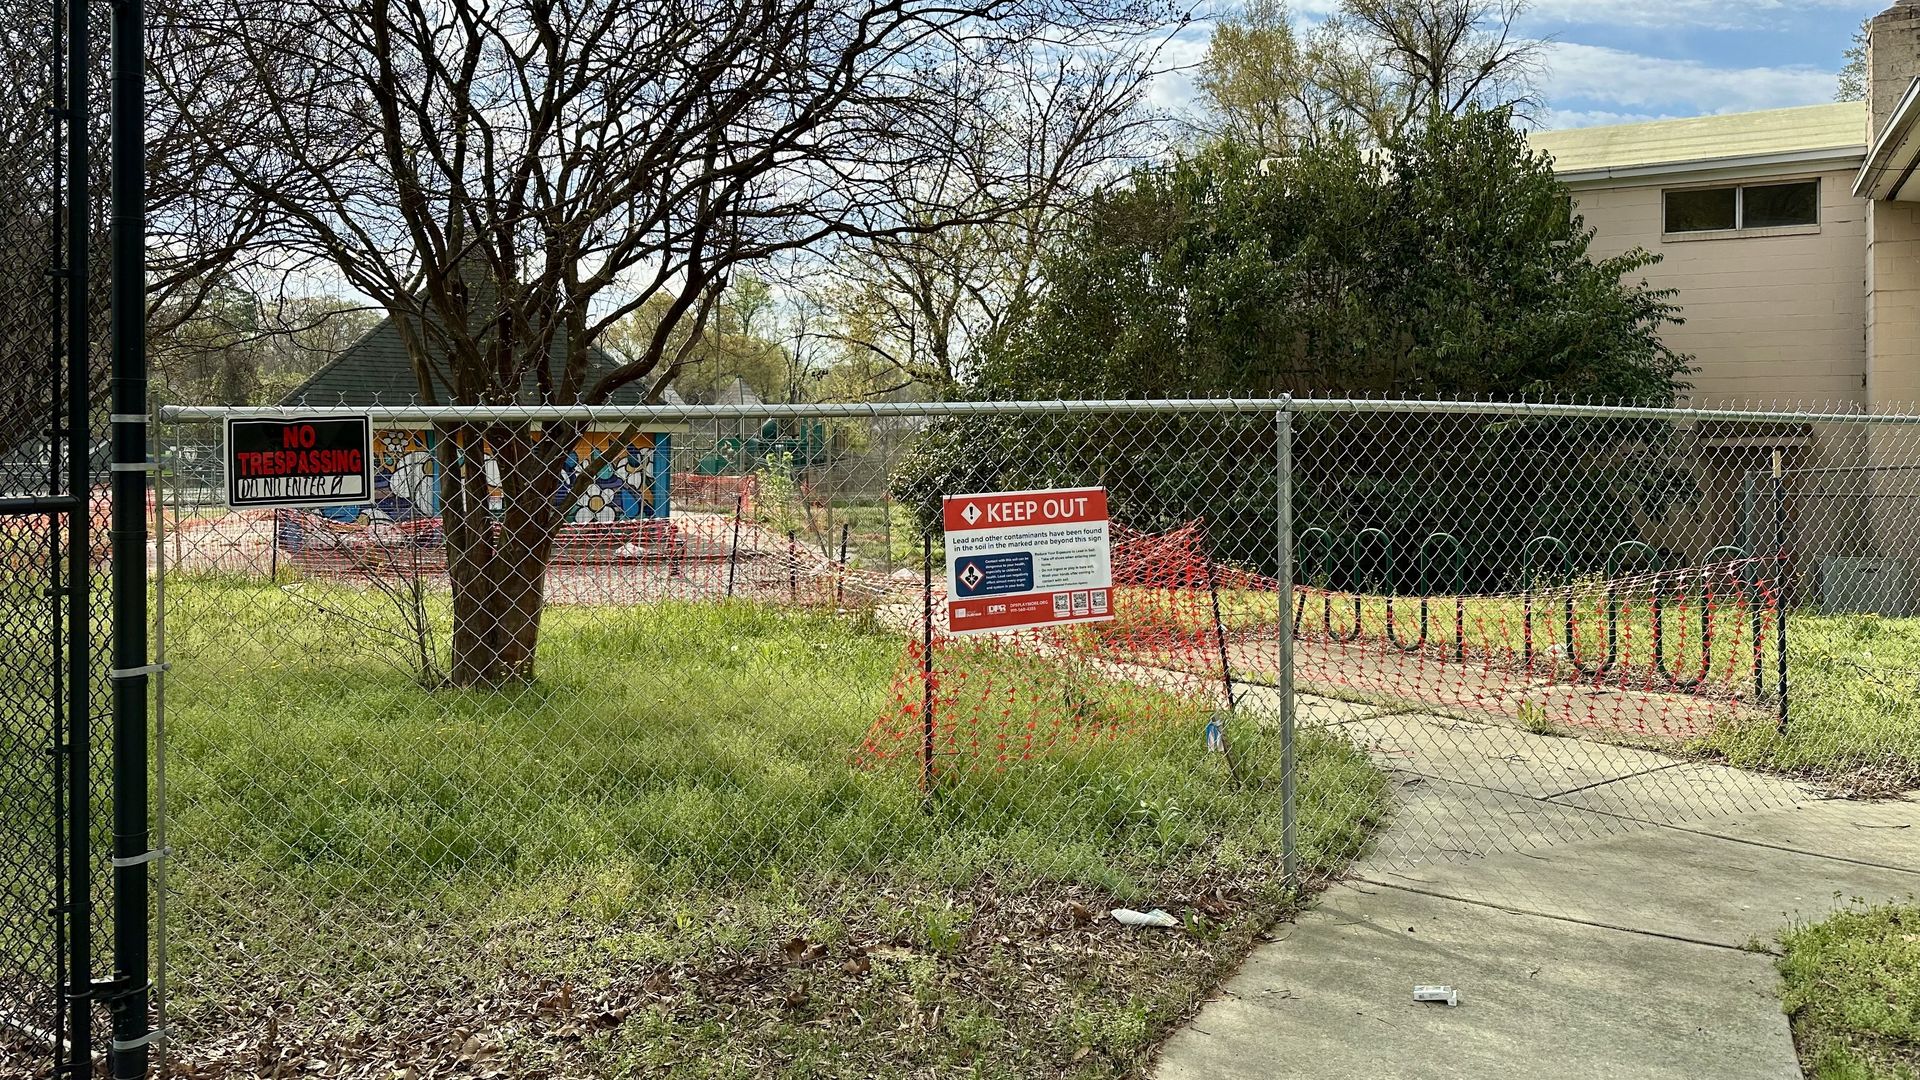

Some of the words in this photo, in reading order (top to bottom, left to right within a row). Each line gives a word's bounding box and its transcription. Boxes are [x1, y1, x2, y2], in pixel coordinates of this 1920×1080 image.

[284, 425, 316, 448] NO
[238, 449, 361, 476] TRESPASSING
[242, 479, 258, 498] DO
[286, 476, 325, 496] ENTER
[987, 501, 1037, 522] KEEP
[1043, 498, 1088, 518] OUT
[1004, 532, 1047, 540] contaminants
[1050, 537, 1073, 546] beyond
[1088, 535, 1102, 543] sign
